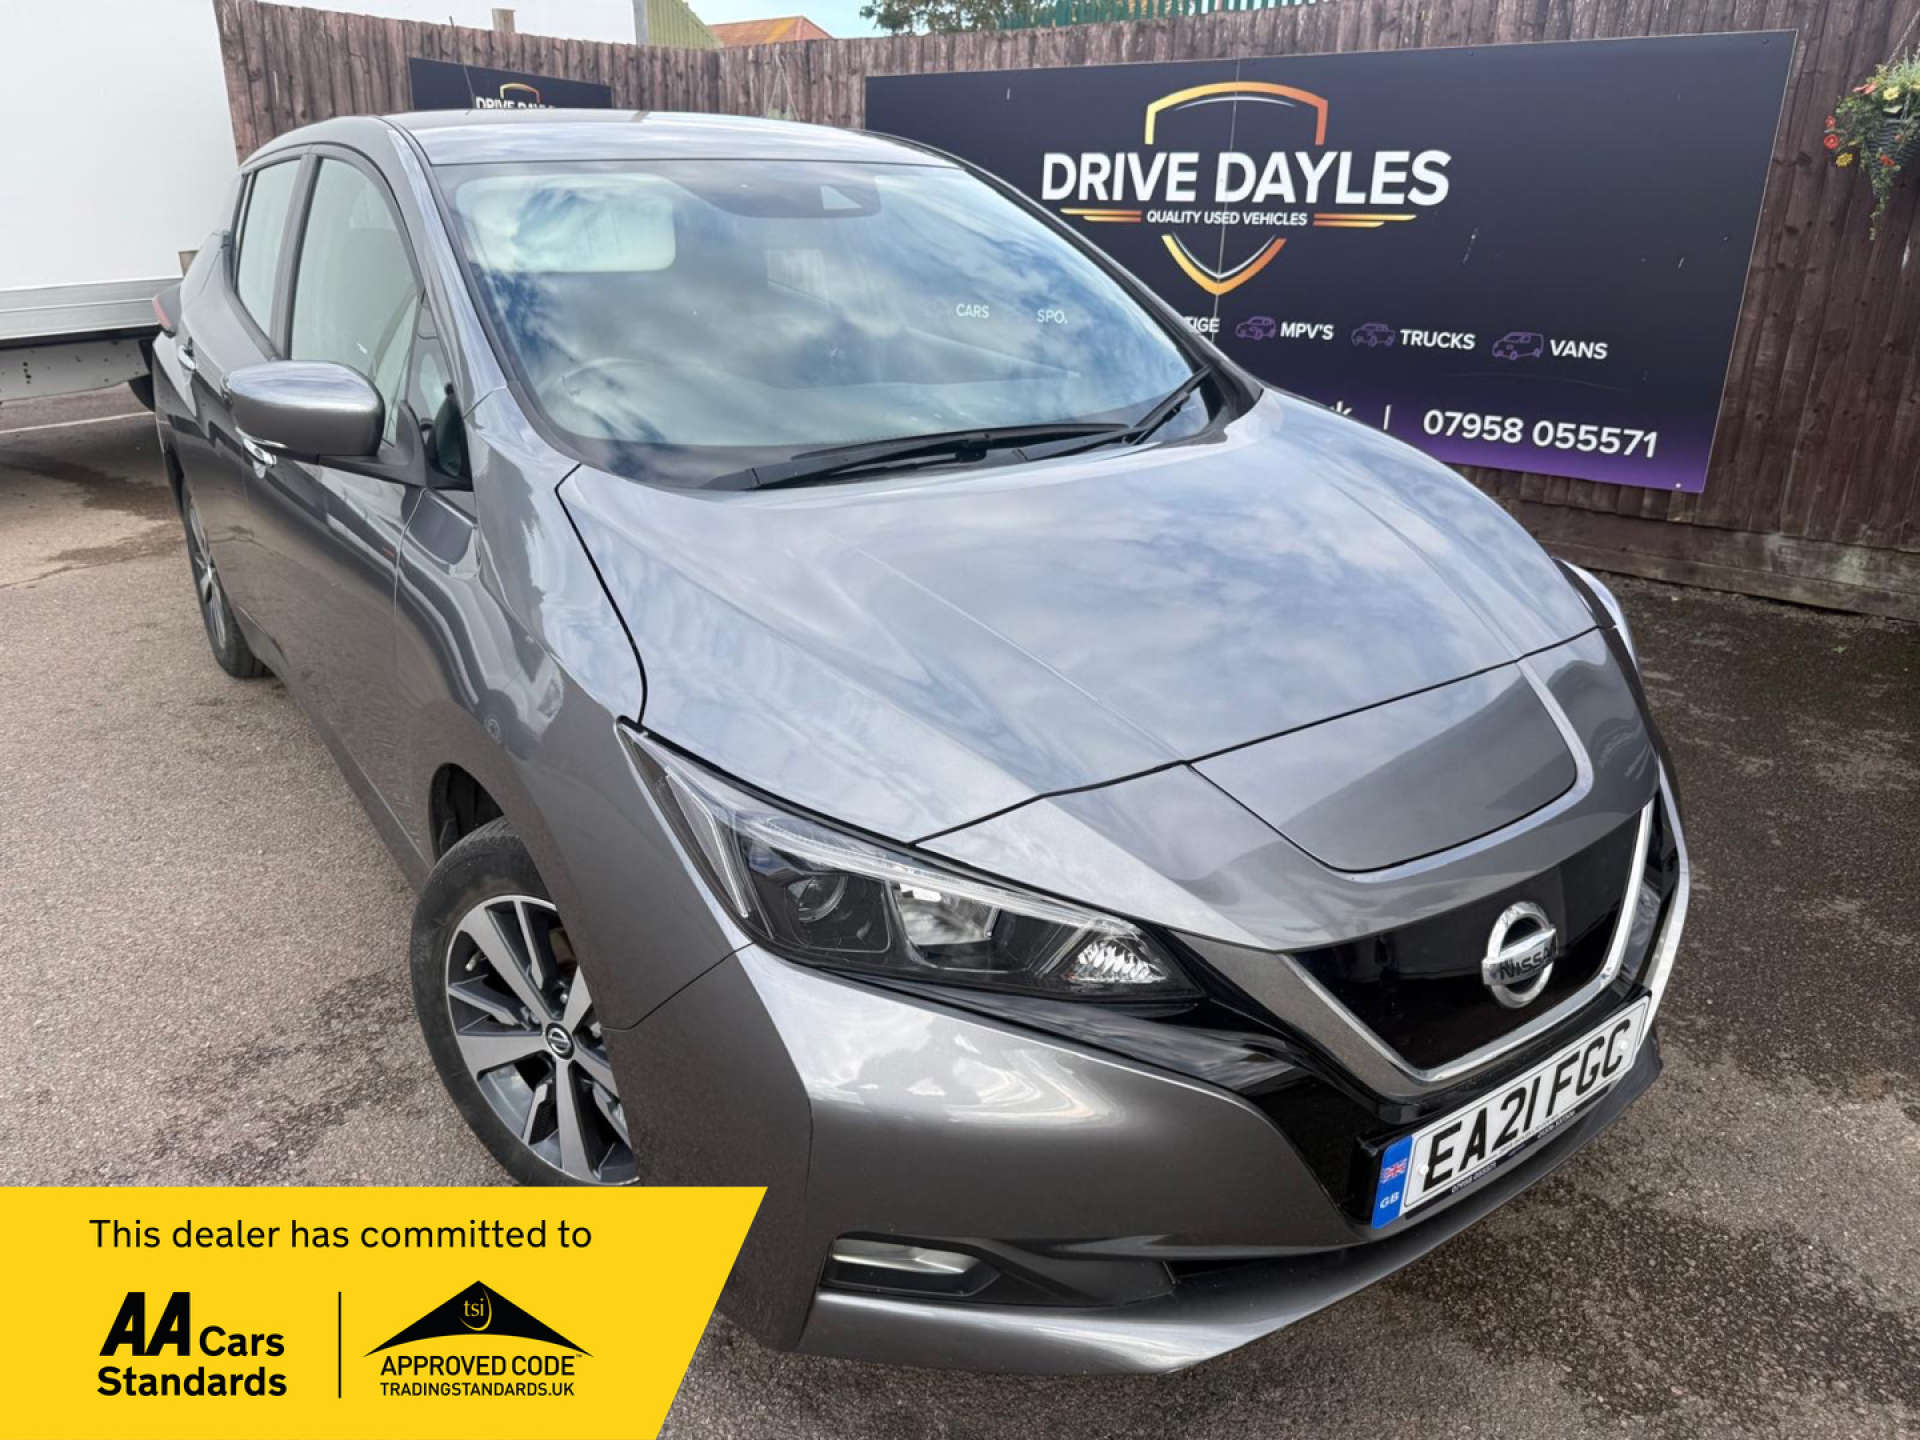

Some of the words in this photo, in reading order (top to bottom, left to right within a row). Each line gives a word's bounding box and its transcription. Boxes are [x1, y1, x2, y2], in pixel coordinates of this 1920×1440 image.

[1042, 152, 1200, 201] DRIVE
[1215, 150, 1452, 206] DAYLES
[1147, 209, 1202, 224] QUALITY
[1204, 211, 1240, 225] USED
[1243, 211, 1308, 227] VEHICLES
[956, 303, 990, 319] CARS
[1037, 309, 1069, 324] SPO
[1280, 321, 1335, 341] MPV'S
[1400, 328, 1476, 351] TRUCKS
[1549, 339, 1608, 360] VANS
[1423, 409, 1524, 444] 07958
[1532, 420, 1658, 459] 055571
[1422, 1076, 1541, 1193] EA21
[1545, 1018, 1632, 1118] FGC
[1379, 1191, 1400, 1209] GB
